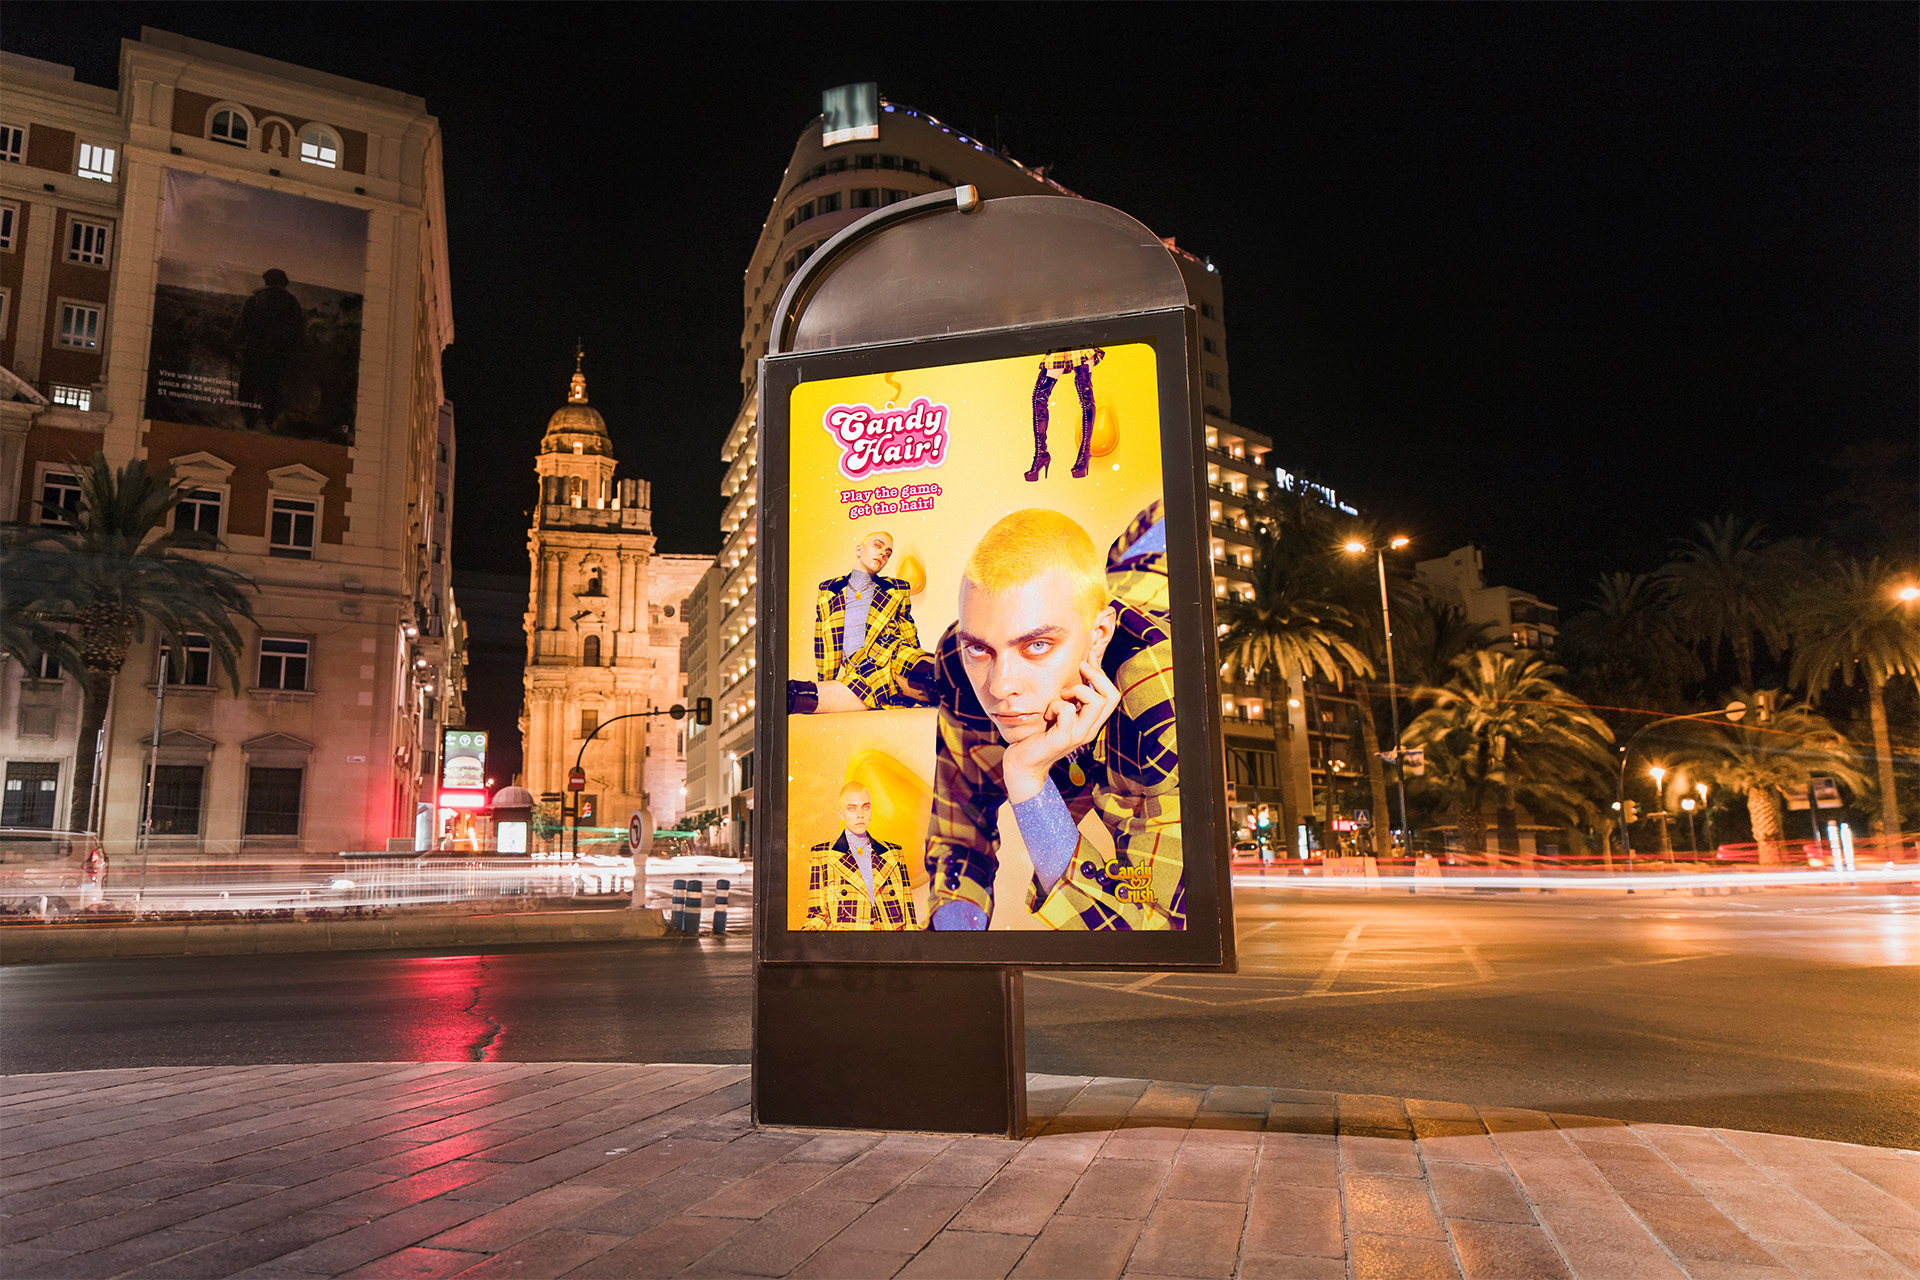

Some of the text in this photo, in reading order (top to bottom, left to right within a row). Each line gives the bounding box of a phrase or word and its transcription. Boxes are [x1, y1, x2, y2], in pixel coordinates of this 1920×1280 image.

[158, 379, 179, 388] única
[181, 382, 191, 390] de
[193, 383, 203, 391] 35
[160, 370, 176, 378] Vive
[194, 375, 239, 387] experiencia
[157, 388, 167, 396] 51
[169, 391, 211, 402] municipios
[225, 399, 264, 410] comarcas.
[830, 403, 942, 441] Candy
[846, 433, 943, 472] Hair!
[841, 483, 943, 503] Play the game,
[849, 497, 934, 519] get the hair!
[1105, 858, 1153, 889] Candy
[1114, 882, 1159, 904] Crush
